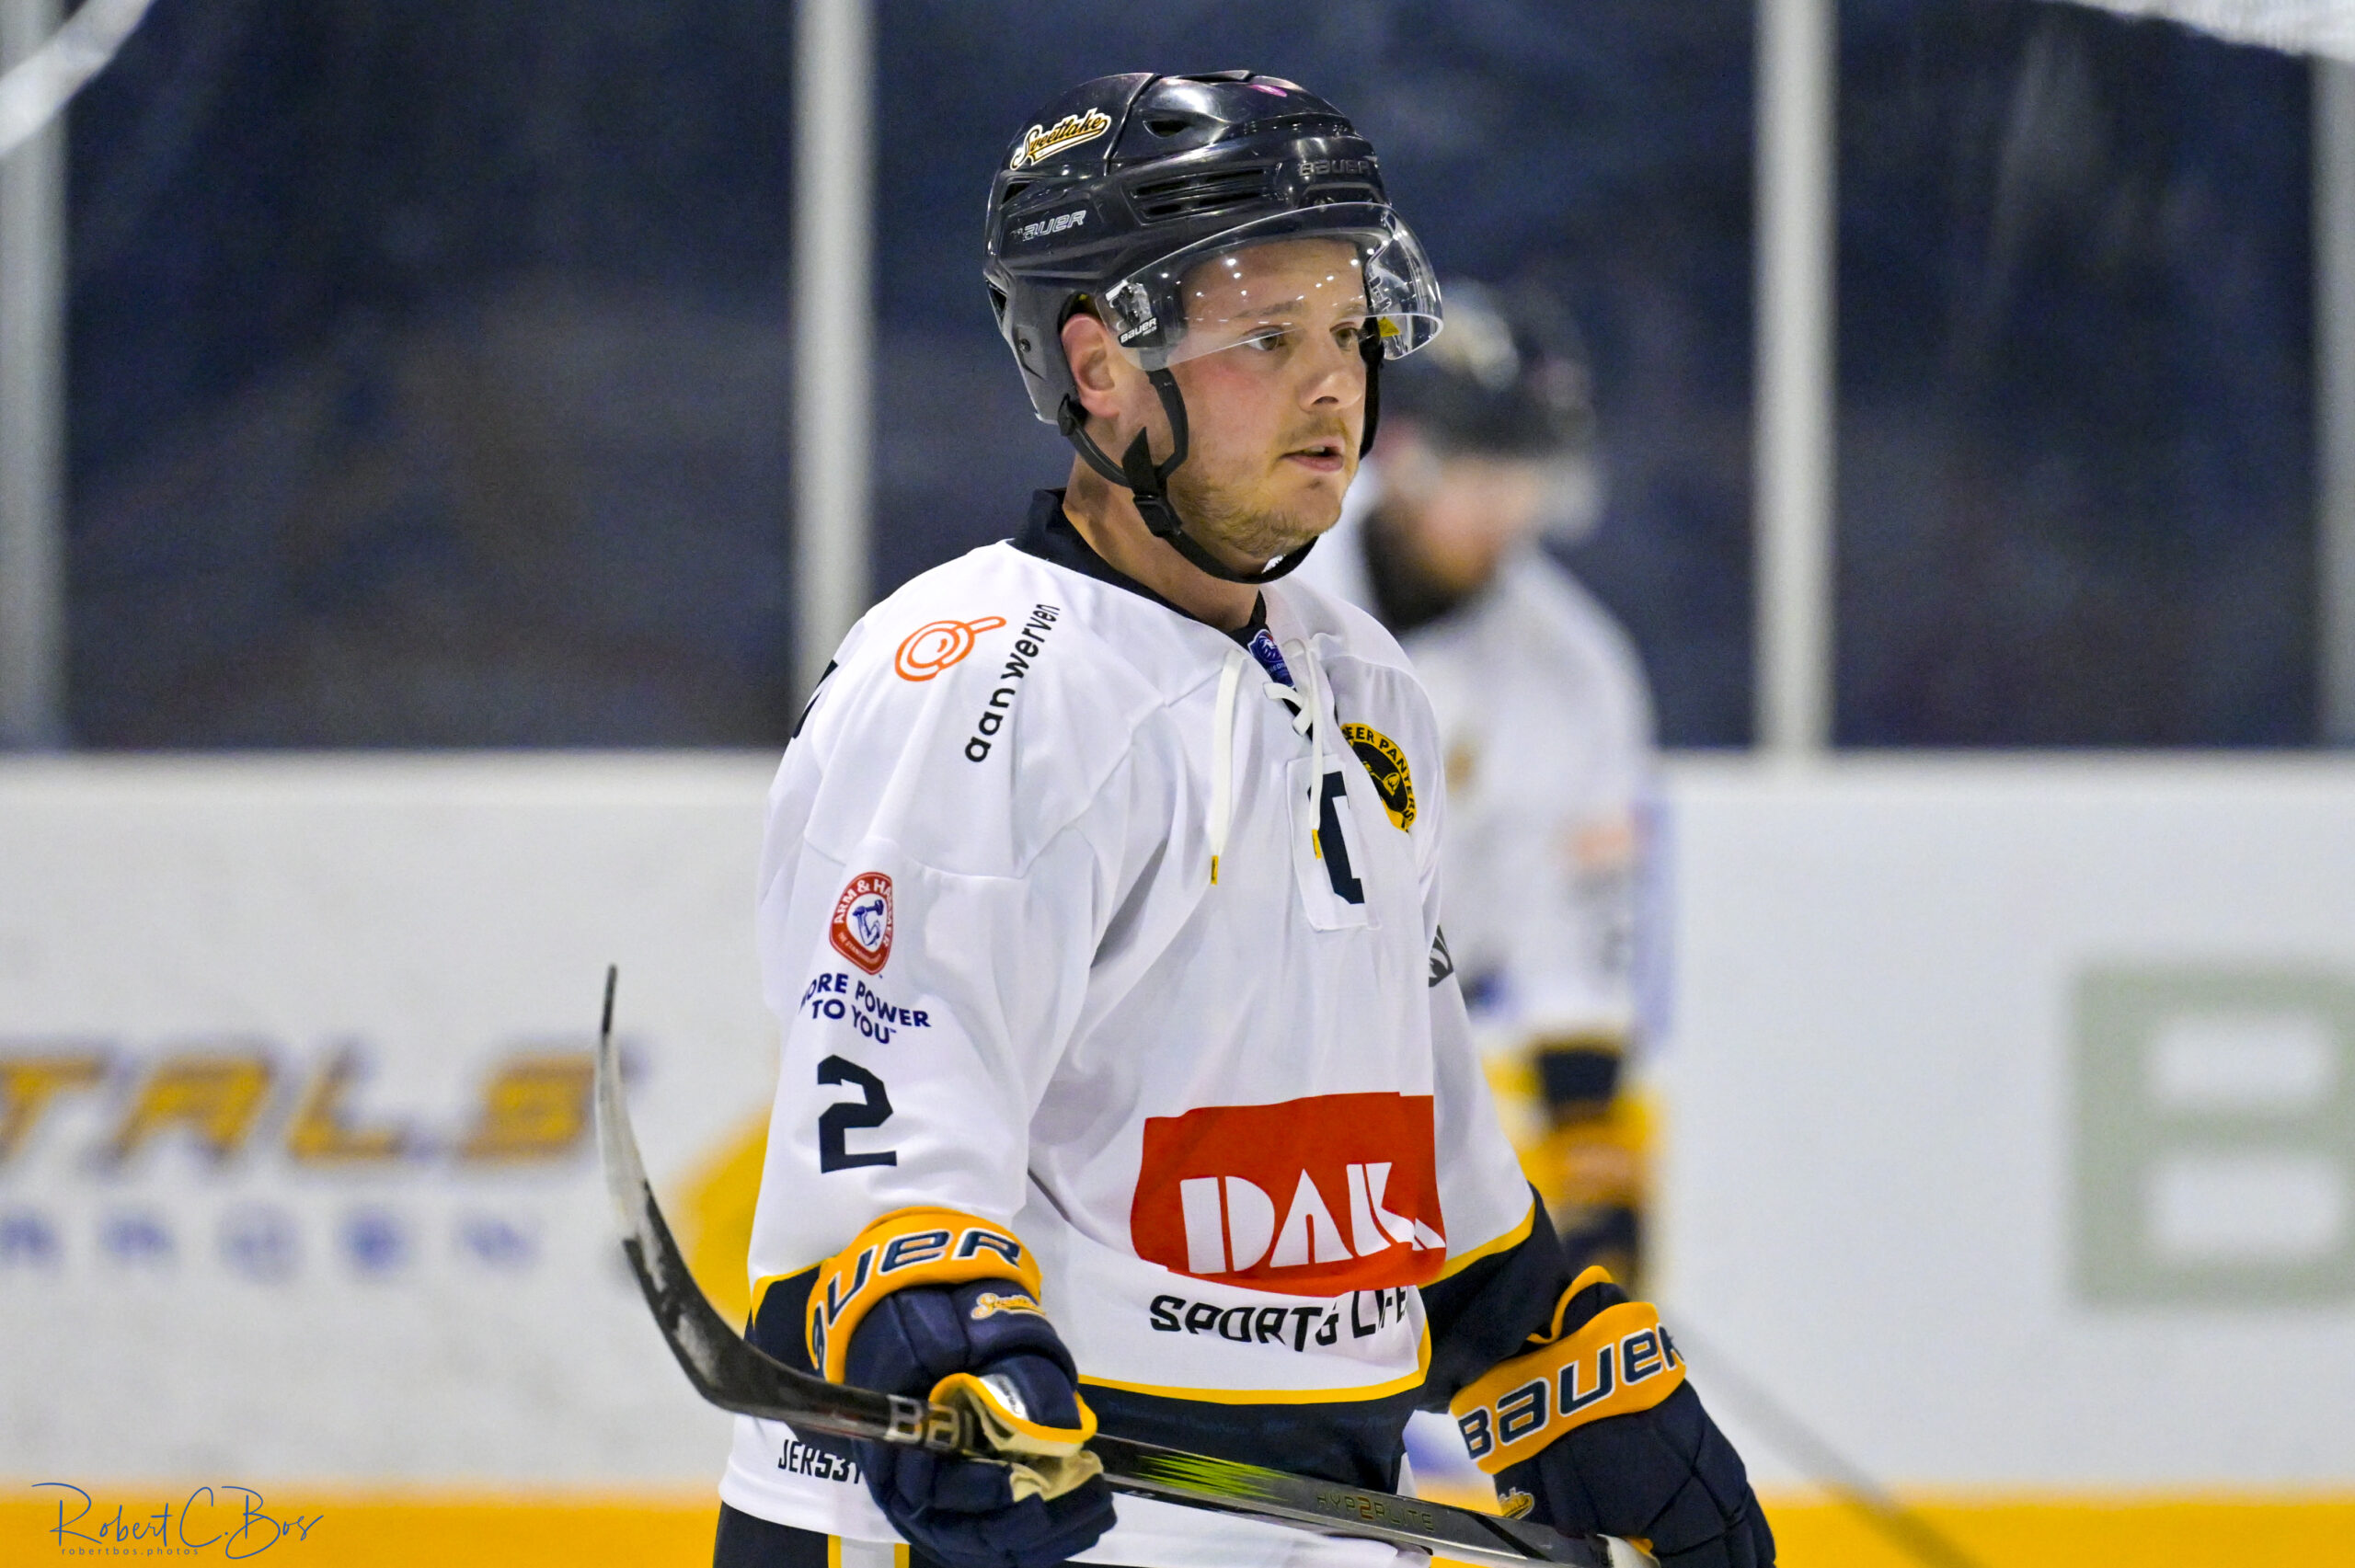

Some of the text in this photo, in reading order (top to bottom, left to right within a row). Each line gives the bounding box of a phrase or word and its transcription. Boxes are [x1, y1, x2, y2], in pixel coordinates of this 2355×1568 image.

[1010, 108, 1111, 170] Sweetlake
[1011, 210, 1086, 242] AUER
[1120, 317, 1156, 343] BAUER
[964, 603, 1061, 762] aan werven
[833, 888, 857, 924] ARM
[856, 879, 870, 893] &
[812, 999, 845, 1020] TO
[856, 980, 931, 1027] POWER
[817, 1054, 897, 1174] 2
[1180, 1162, 1446, 1275] DAK
